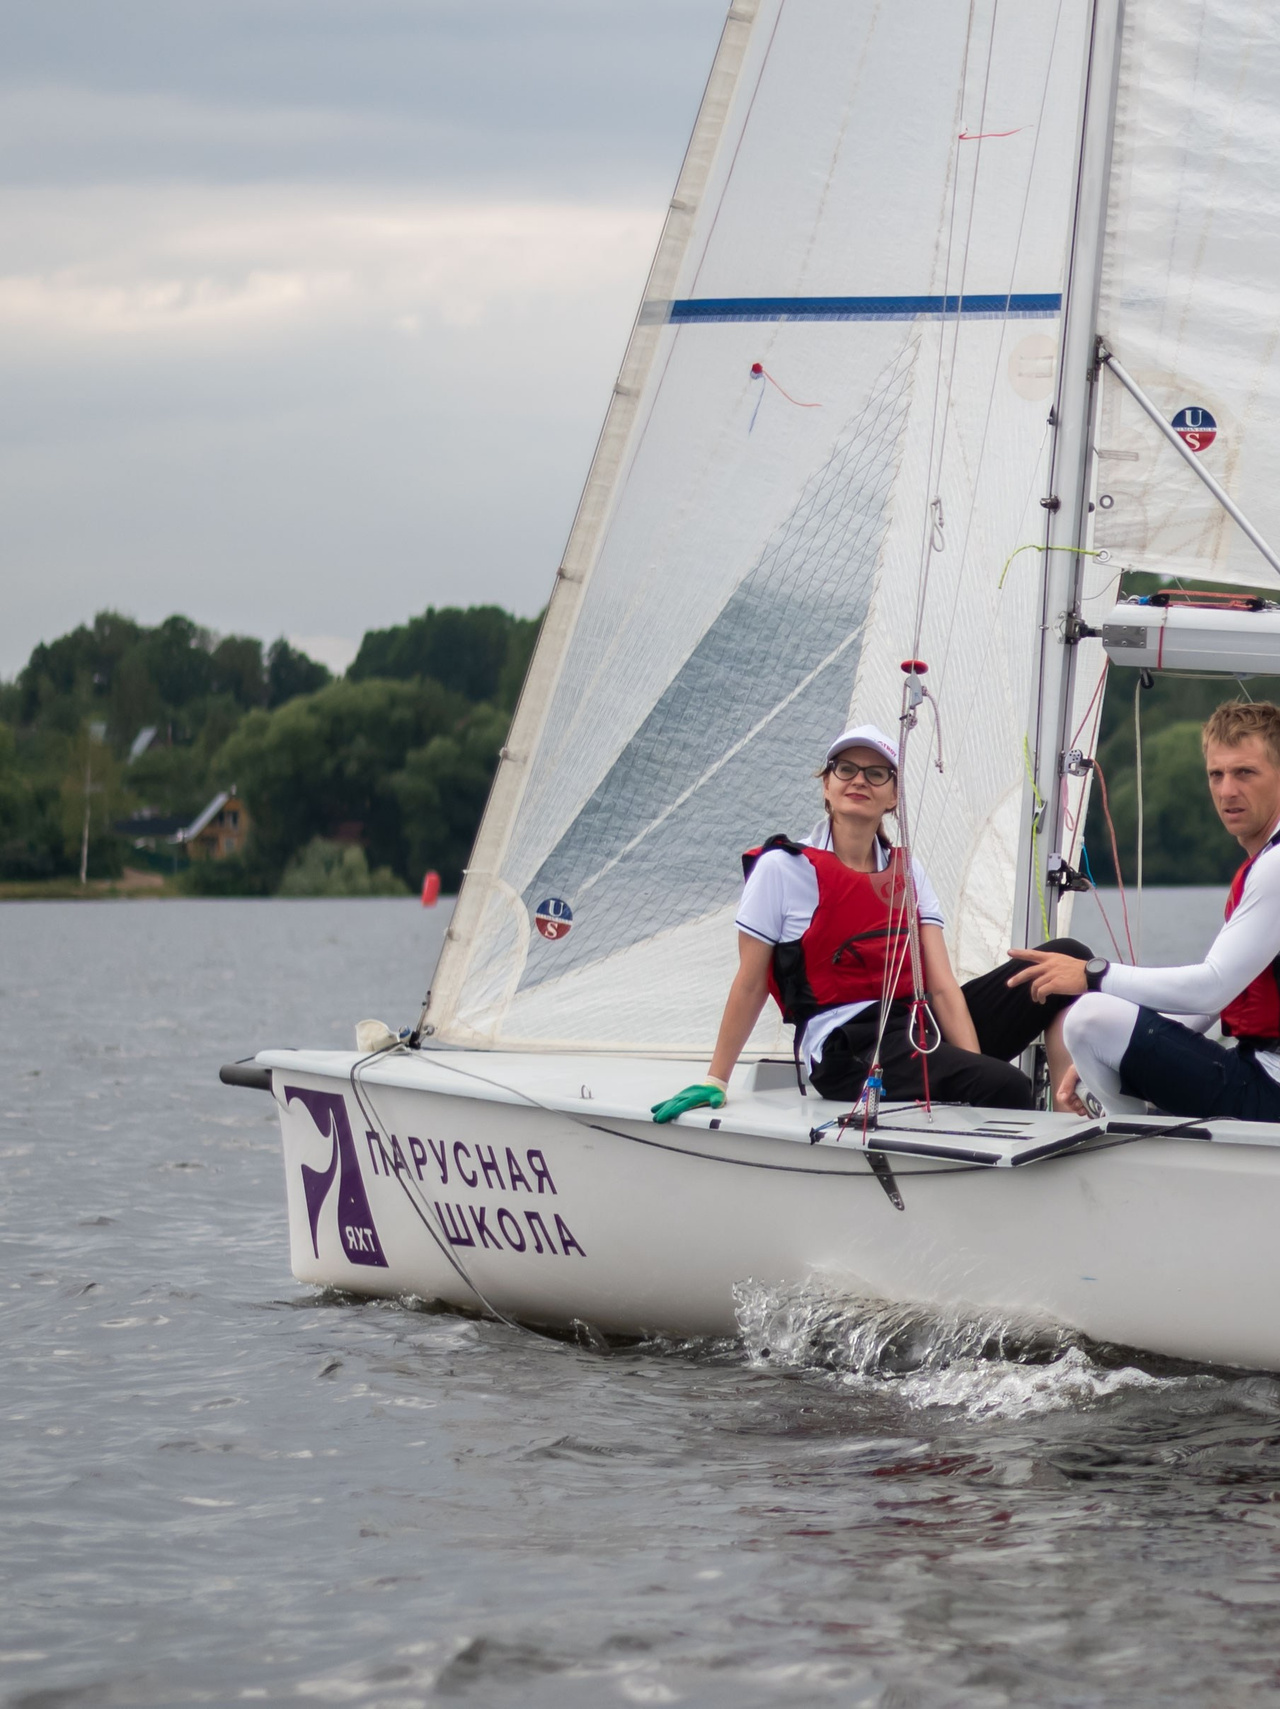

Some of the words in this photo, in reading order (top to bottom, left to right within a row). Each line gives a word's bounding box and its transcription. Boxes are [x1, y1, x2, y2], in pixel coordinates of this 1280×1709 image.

[1185, 410, 1203, 427] U
[1185, 432, 1201, 450] S
[365, 1131, 558, 1195] ПАРУСНАЯ
[345, 1225, 376, 1253] ЯХТ
[434, 1202, 587, 1257] ШКОЛА
